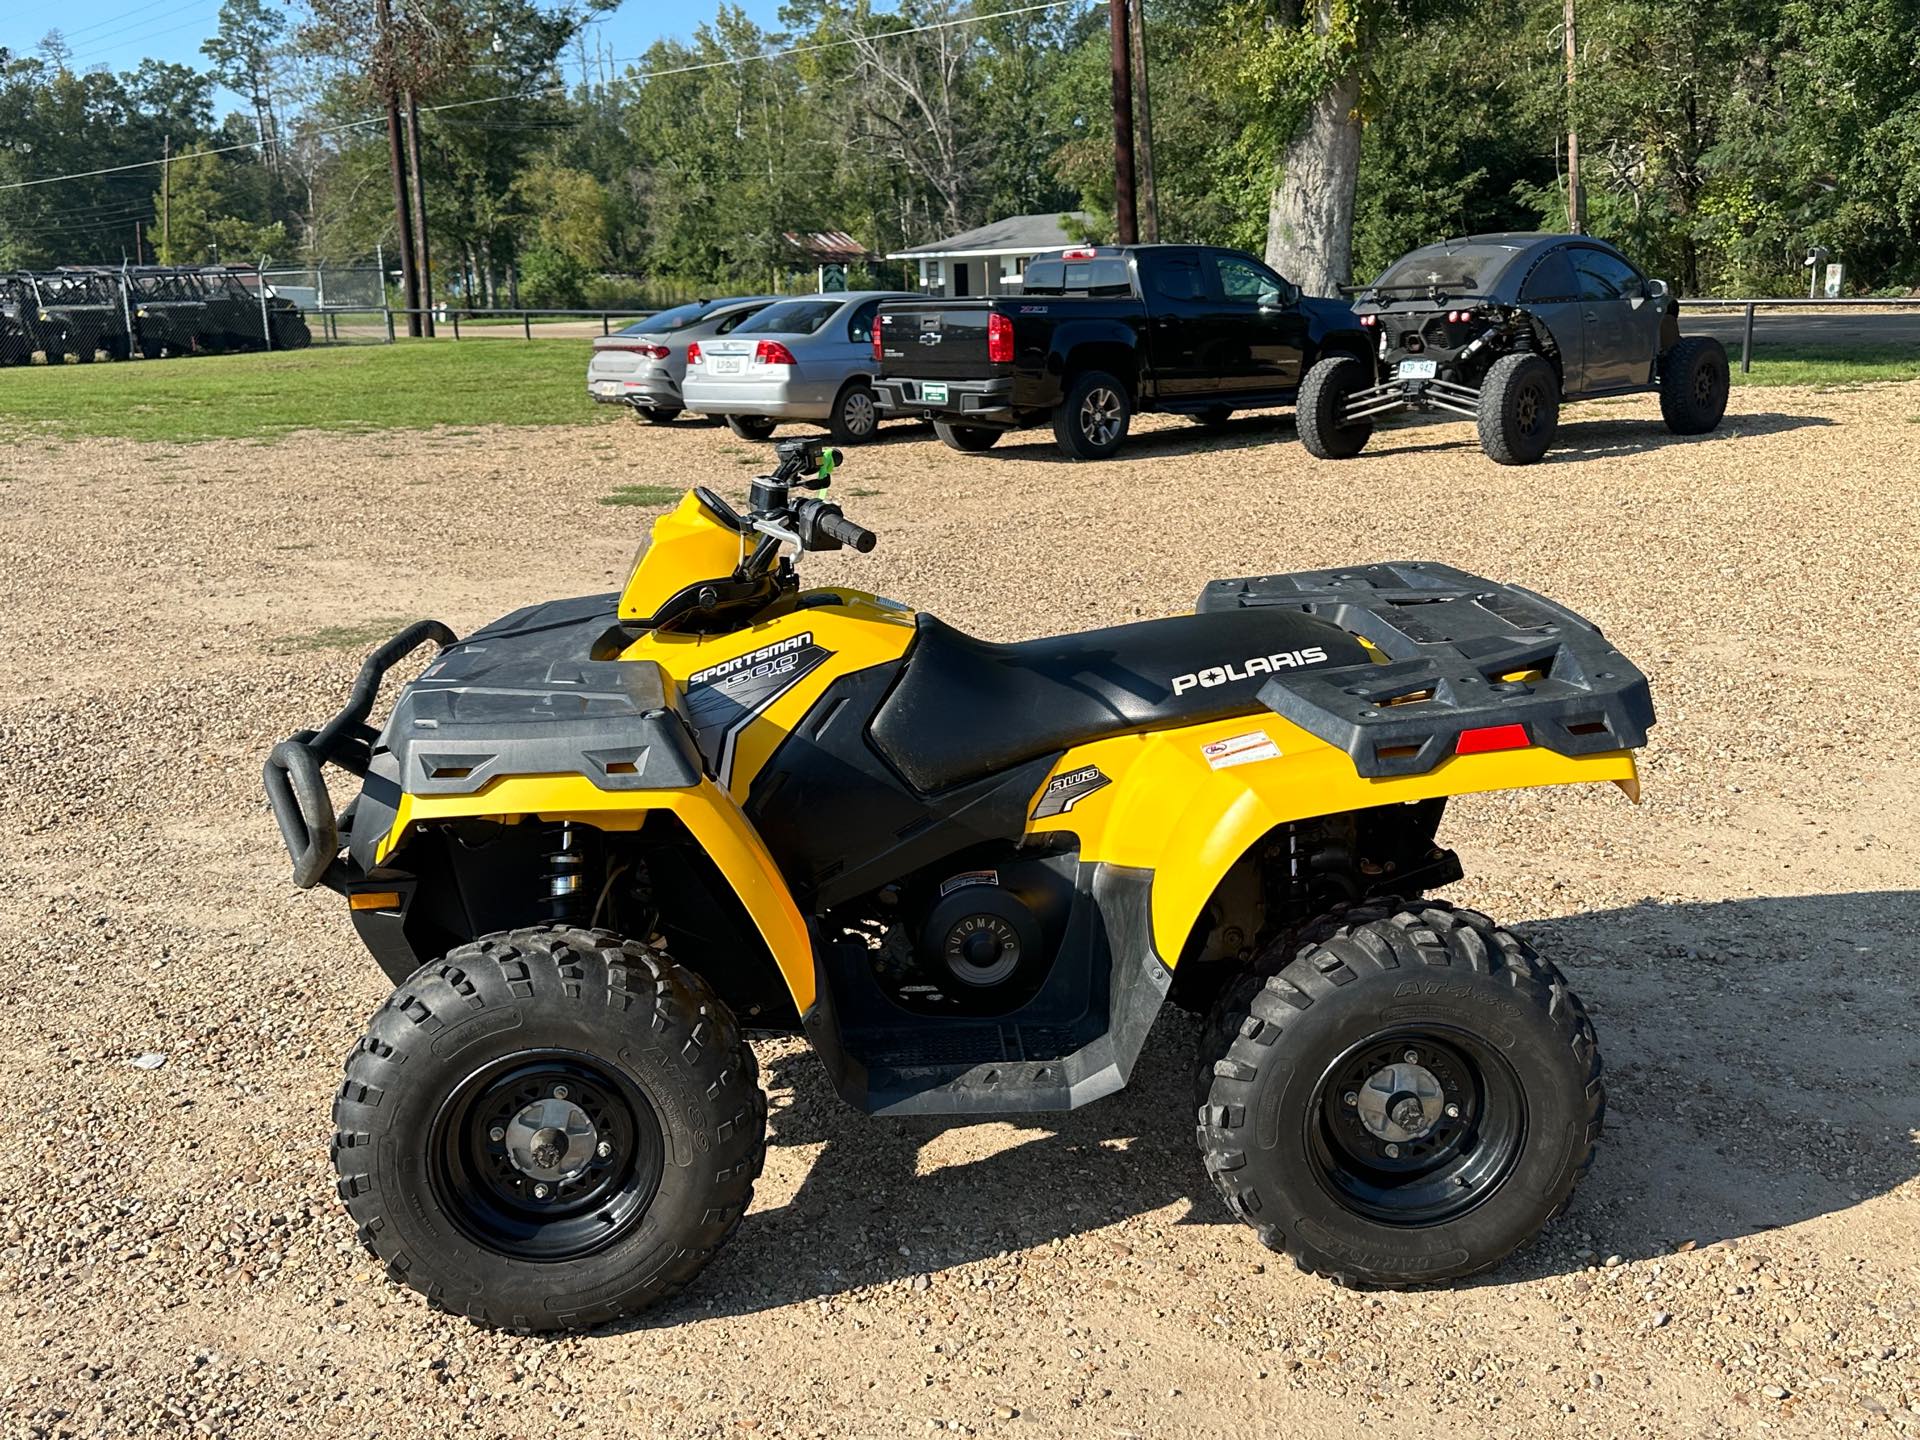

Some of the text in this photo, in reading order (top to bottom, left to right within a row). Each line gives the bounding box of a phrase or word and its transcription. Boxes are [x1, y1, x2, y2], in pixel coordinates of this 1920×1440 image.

[689, 632, 812, 687] SPORTSMAN
[725, 652, 799, 689] 500
[1171, 646, 1328, 696] POLARIS
[1049, 768, 1099, 793] AWD
[949, 918, 1015, 954] AUTOMATIC
